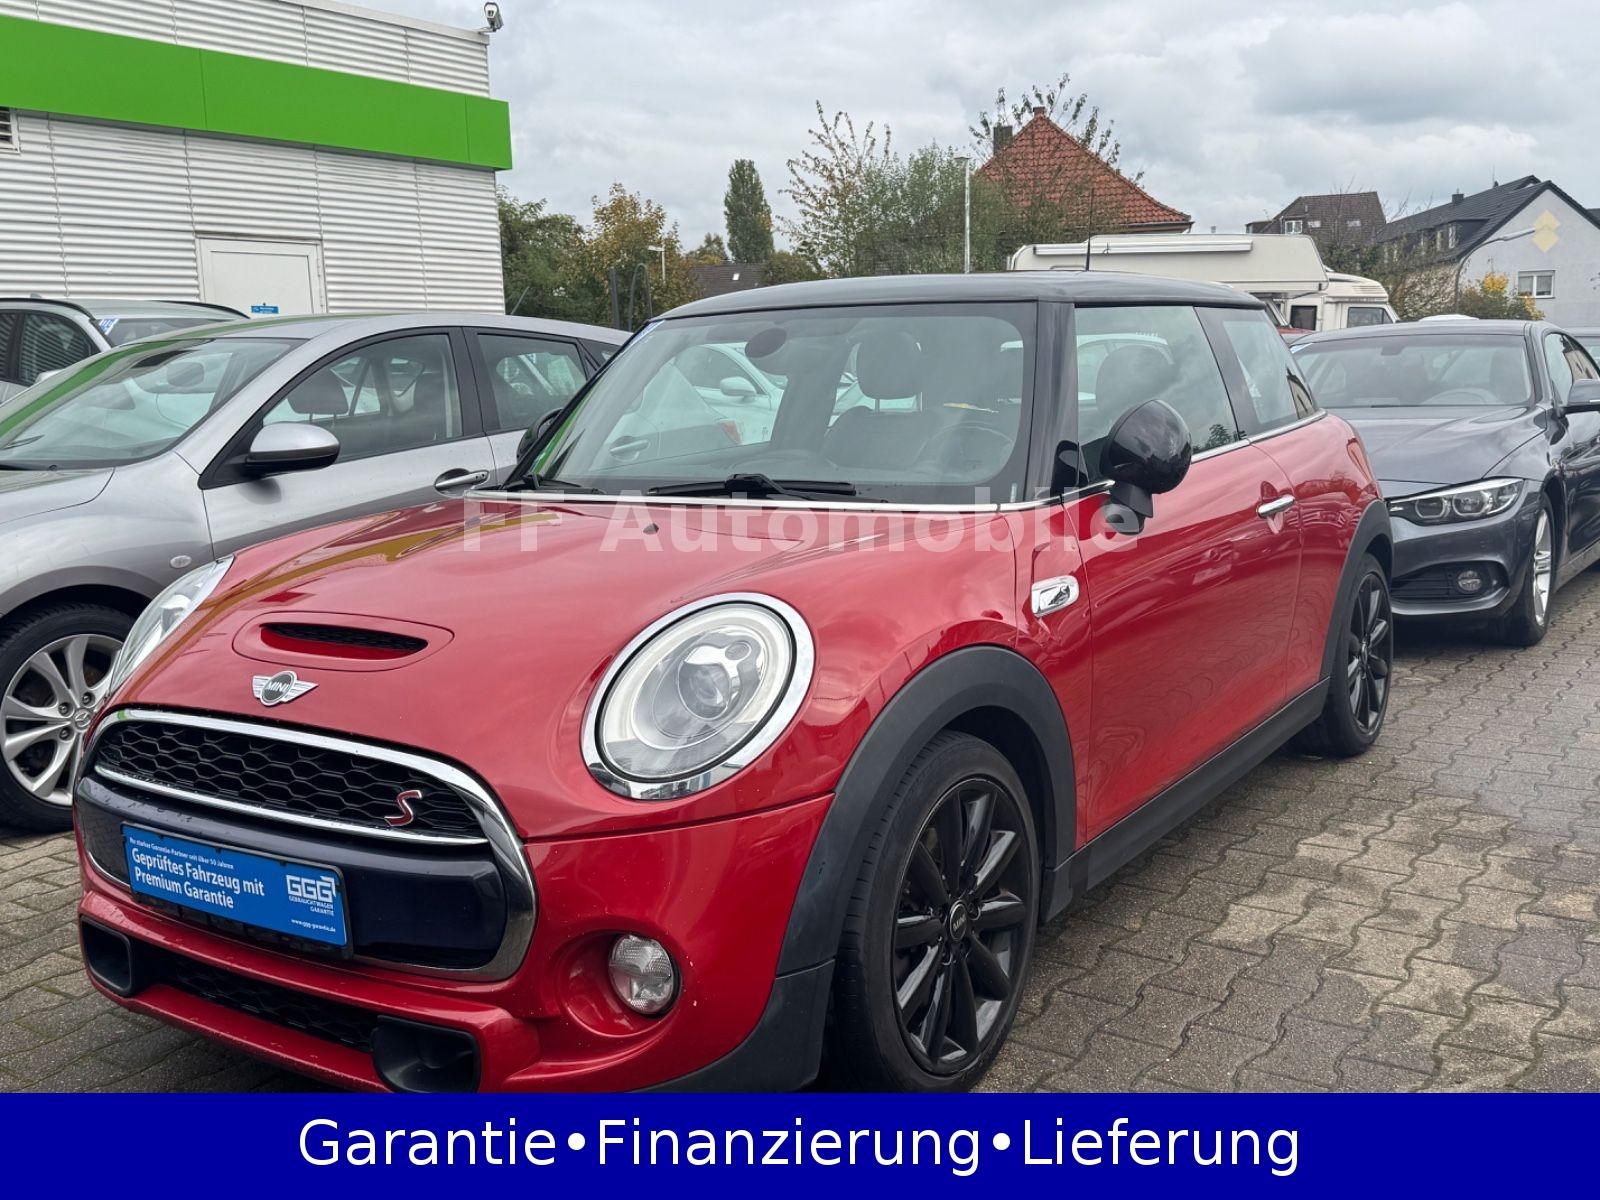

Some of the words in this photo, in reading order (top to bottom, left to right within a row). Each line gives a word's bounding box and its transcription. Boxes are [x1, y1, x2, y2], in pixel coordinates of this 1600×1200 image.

[132, 847, 184, 876] Geprüftes
[186, 862, 240, 895] Fahrzeug
[243, 878, 265, 896] mit
[134, 866, 182, 894] Premium
[184, 881, 234, 909] Garantie
